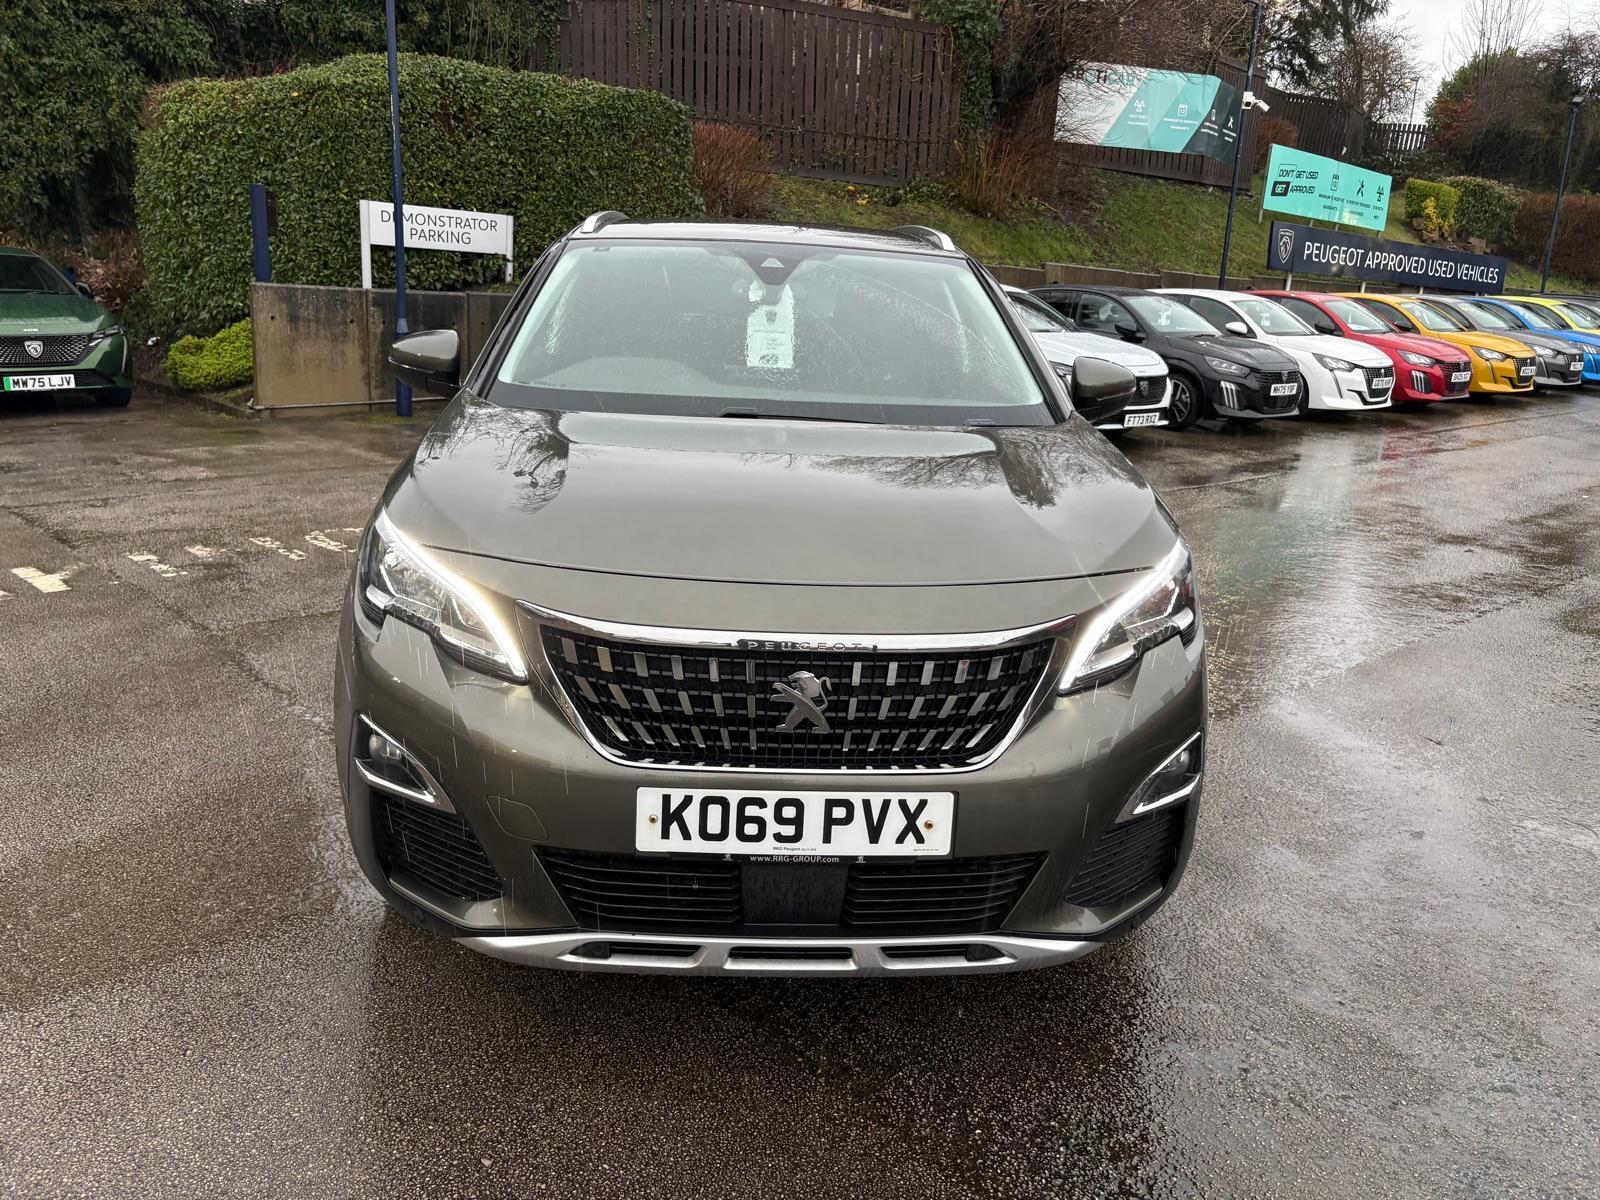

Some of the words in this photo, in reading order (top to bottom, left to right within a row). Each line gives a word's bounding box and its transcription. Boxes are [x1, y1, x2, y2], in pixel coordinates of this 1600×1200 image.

[1279, 169, 1295, 178] DON'T
[1296, 170, 1306, 179] GET
[1306, 171, 1318, 179] USED
[1275, 184, 1287, 193] GET
[1289, 185, 1315, 194] APPROVED
[381, 211, 498, 232] DMONSTRATOR
[410, 228, 471, 244] PARKING
[1304, 241, 1364, 267] PEUGEOT
[1365, 252, 1425, 275] APPROVED
[1428, 260, 1455, 279] USED
[1457, 263, 1499, 284] VEHICLES
[12, 378, 45, 389] MW75
[48, 376, 71, 387] LJV
[1127, 416, 1144, 426] FT73
[1145, 414, 1157, 425] RXZ
[747, 641, 861, 651] PEUGEOT
[822, 797, 929, 845] PVX
[750, 855, 840, 864] www.RRG-GROUP.com
